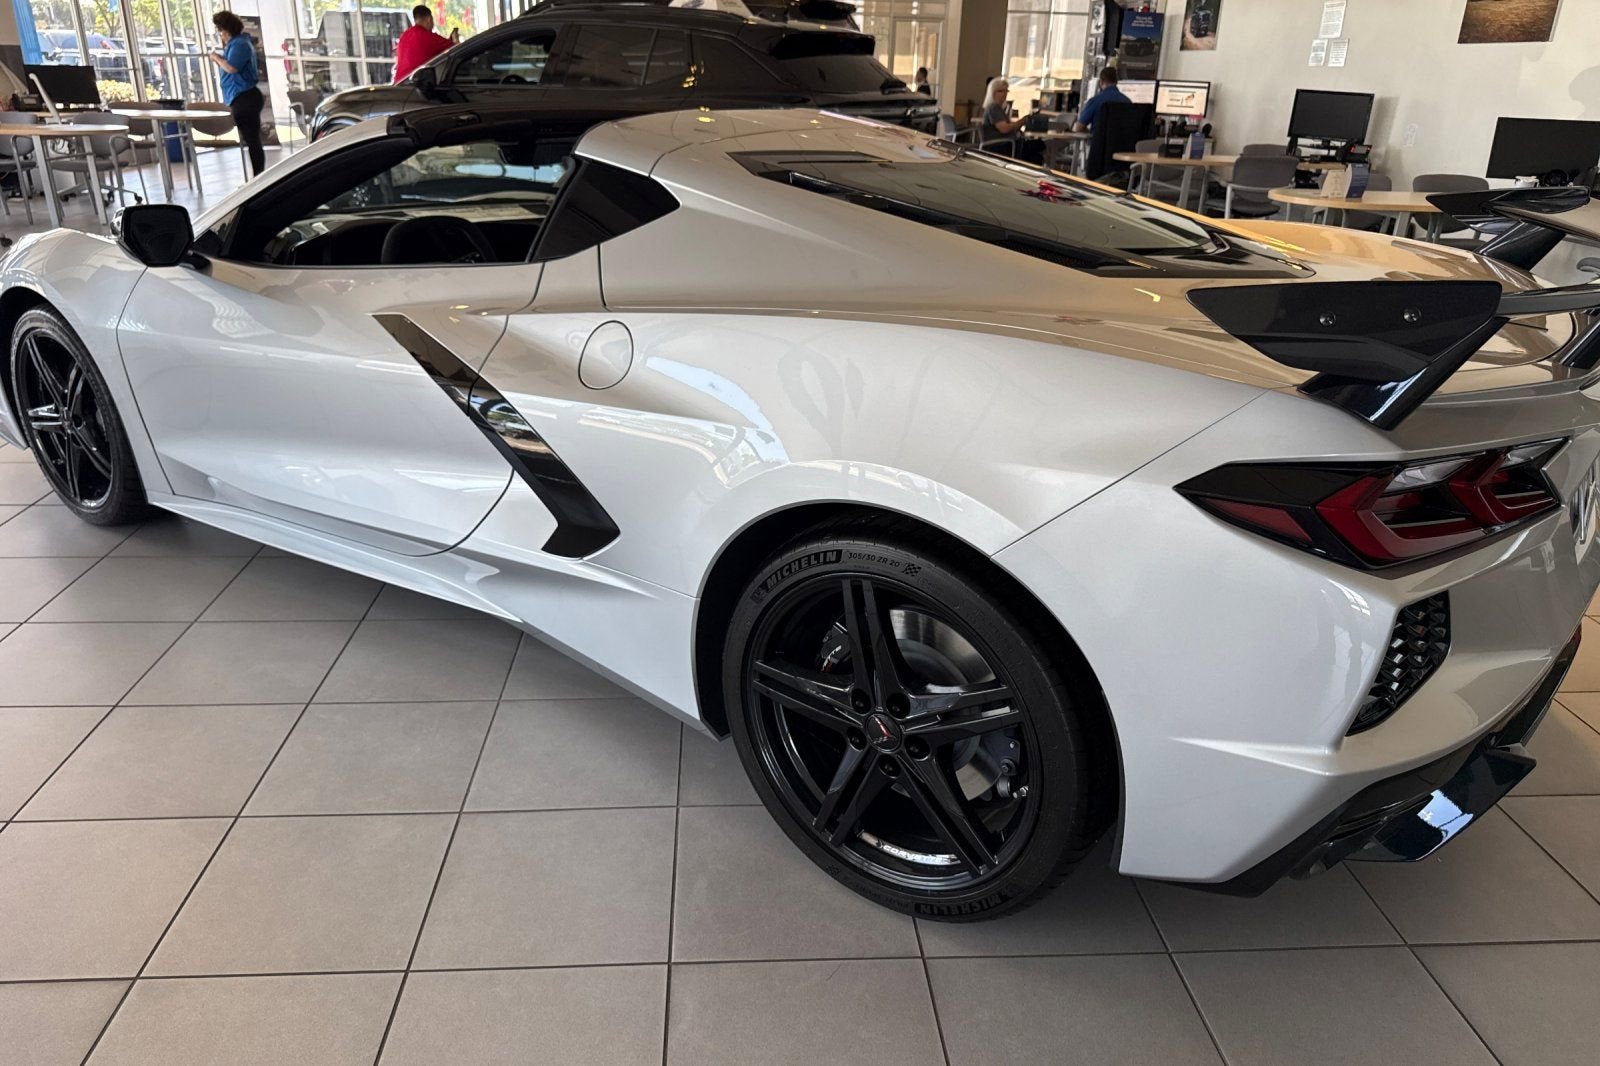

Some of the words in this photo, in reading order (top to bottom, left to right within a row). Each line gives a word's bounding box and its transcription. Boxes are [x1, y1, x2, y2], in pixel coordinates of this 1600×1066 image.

[766, 551, 837, 589] MICHELIN
[848, 552, 875, 562] 305/30
[889, 560, 900, 568] 20
[920, 893, 1002, 915] MICHELIN
